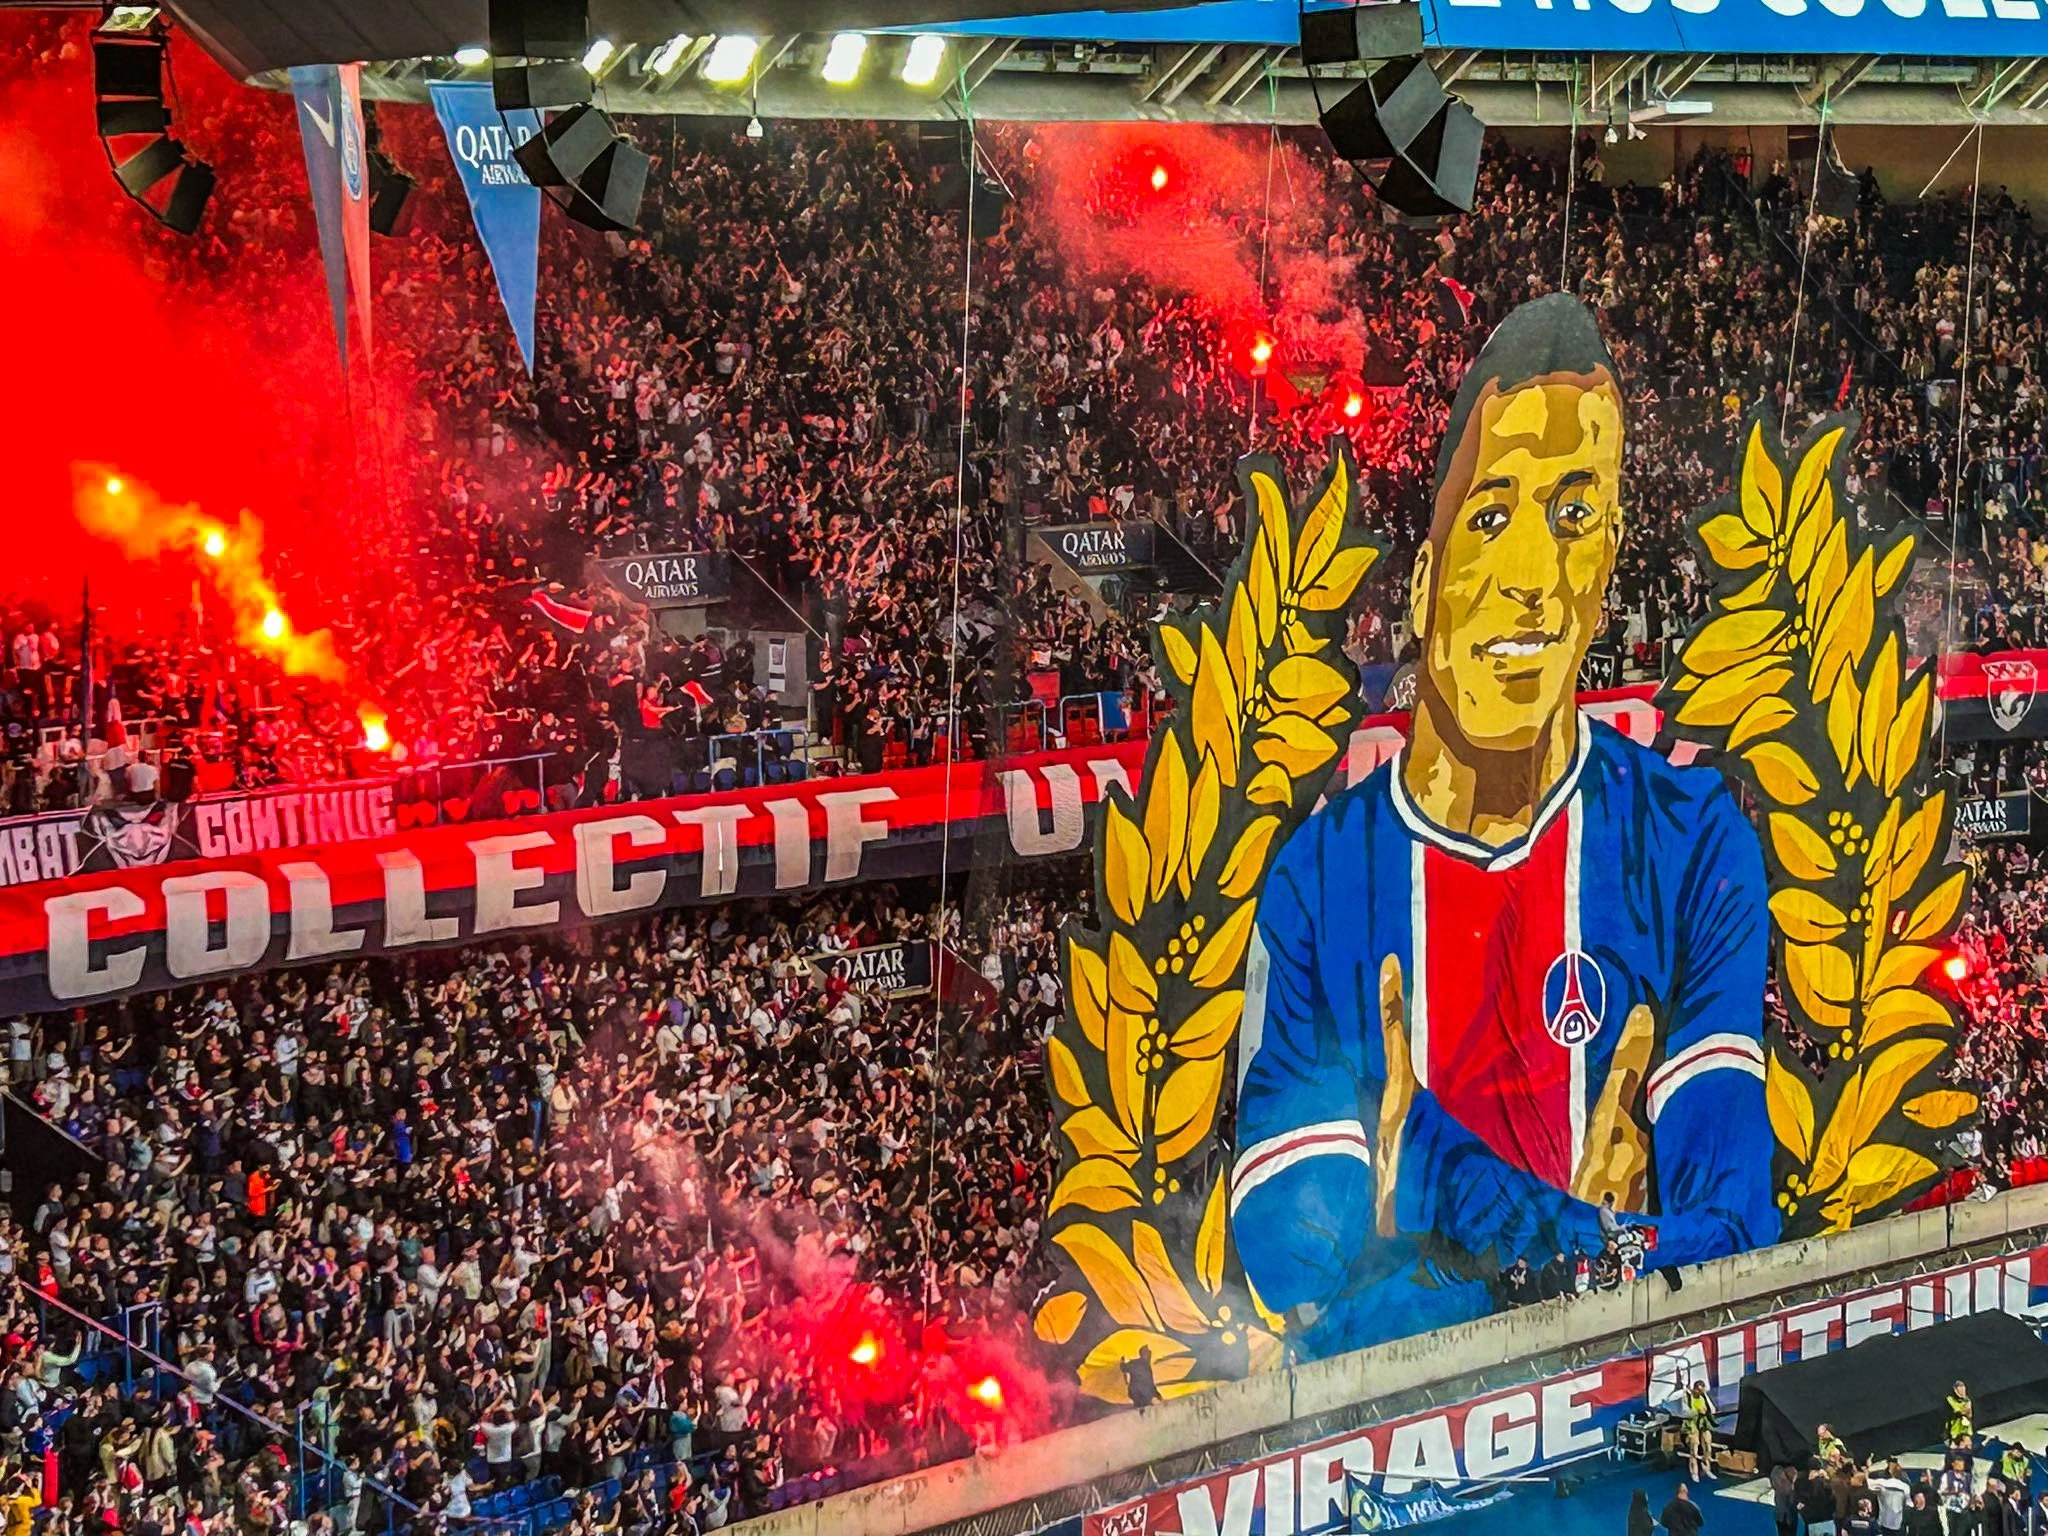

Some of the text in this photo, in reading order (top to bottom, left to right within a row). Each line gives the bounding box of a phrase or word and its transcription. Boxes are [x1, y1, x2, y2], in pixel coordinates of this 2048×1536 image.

[1062, 530, 1126, 558] QATAR
[625, 557, 698, 590] QATAR
[645, 581, 699, 599] AIRWAYS
[197, 786, 398, 858] CONTINUE
[45, 787, 900, 1000] COLLECTIF
[1176, 1371, 1604, 1536] VIRAGE
